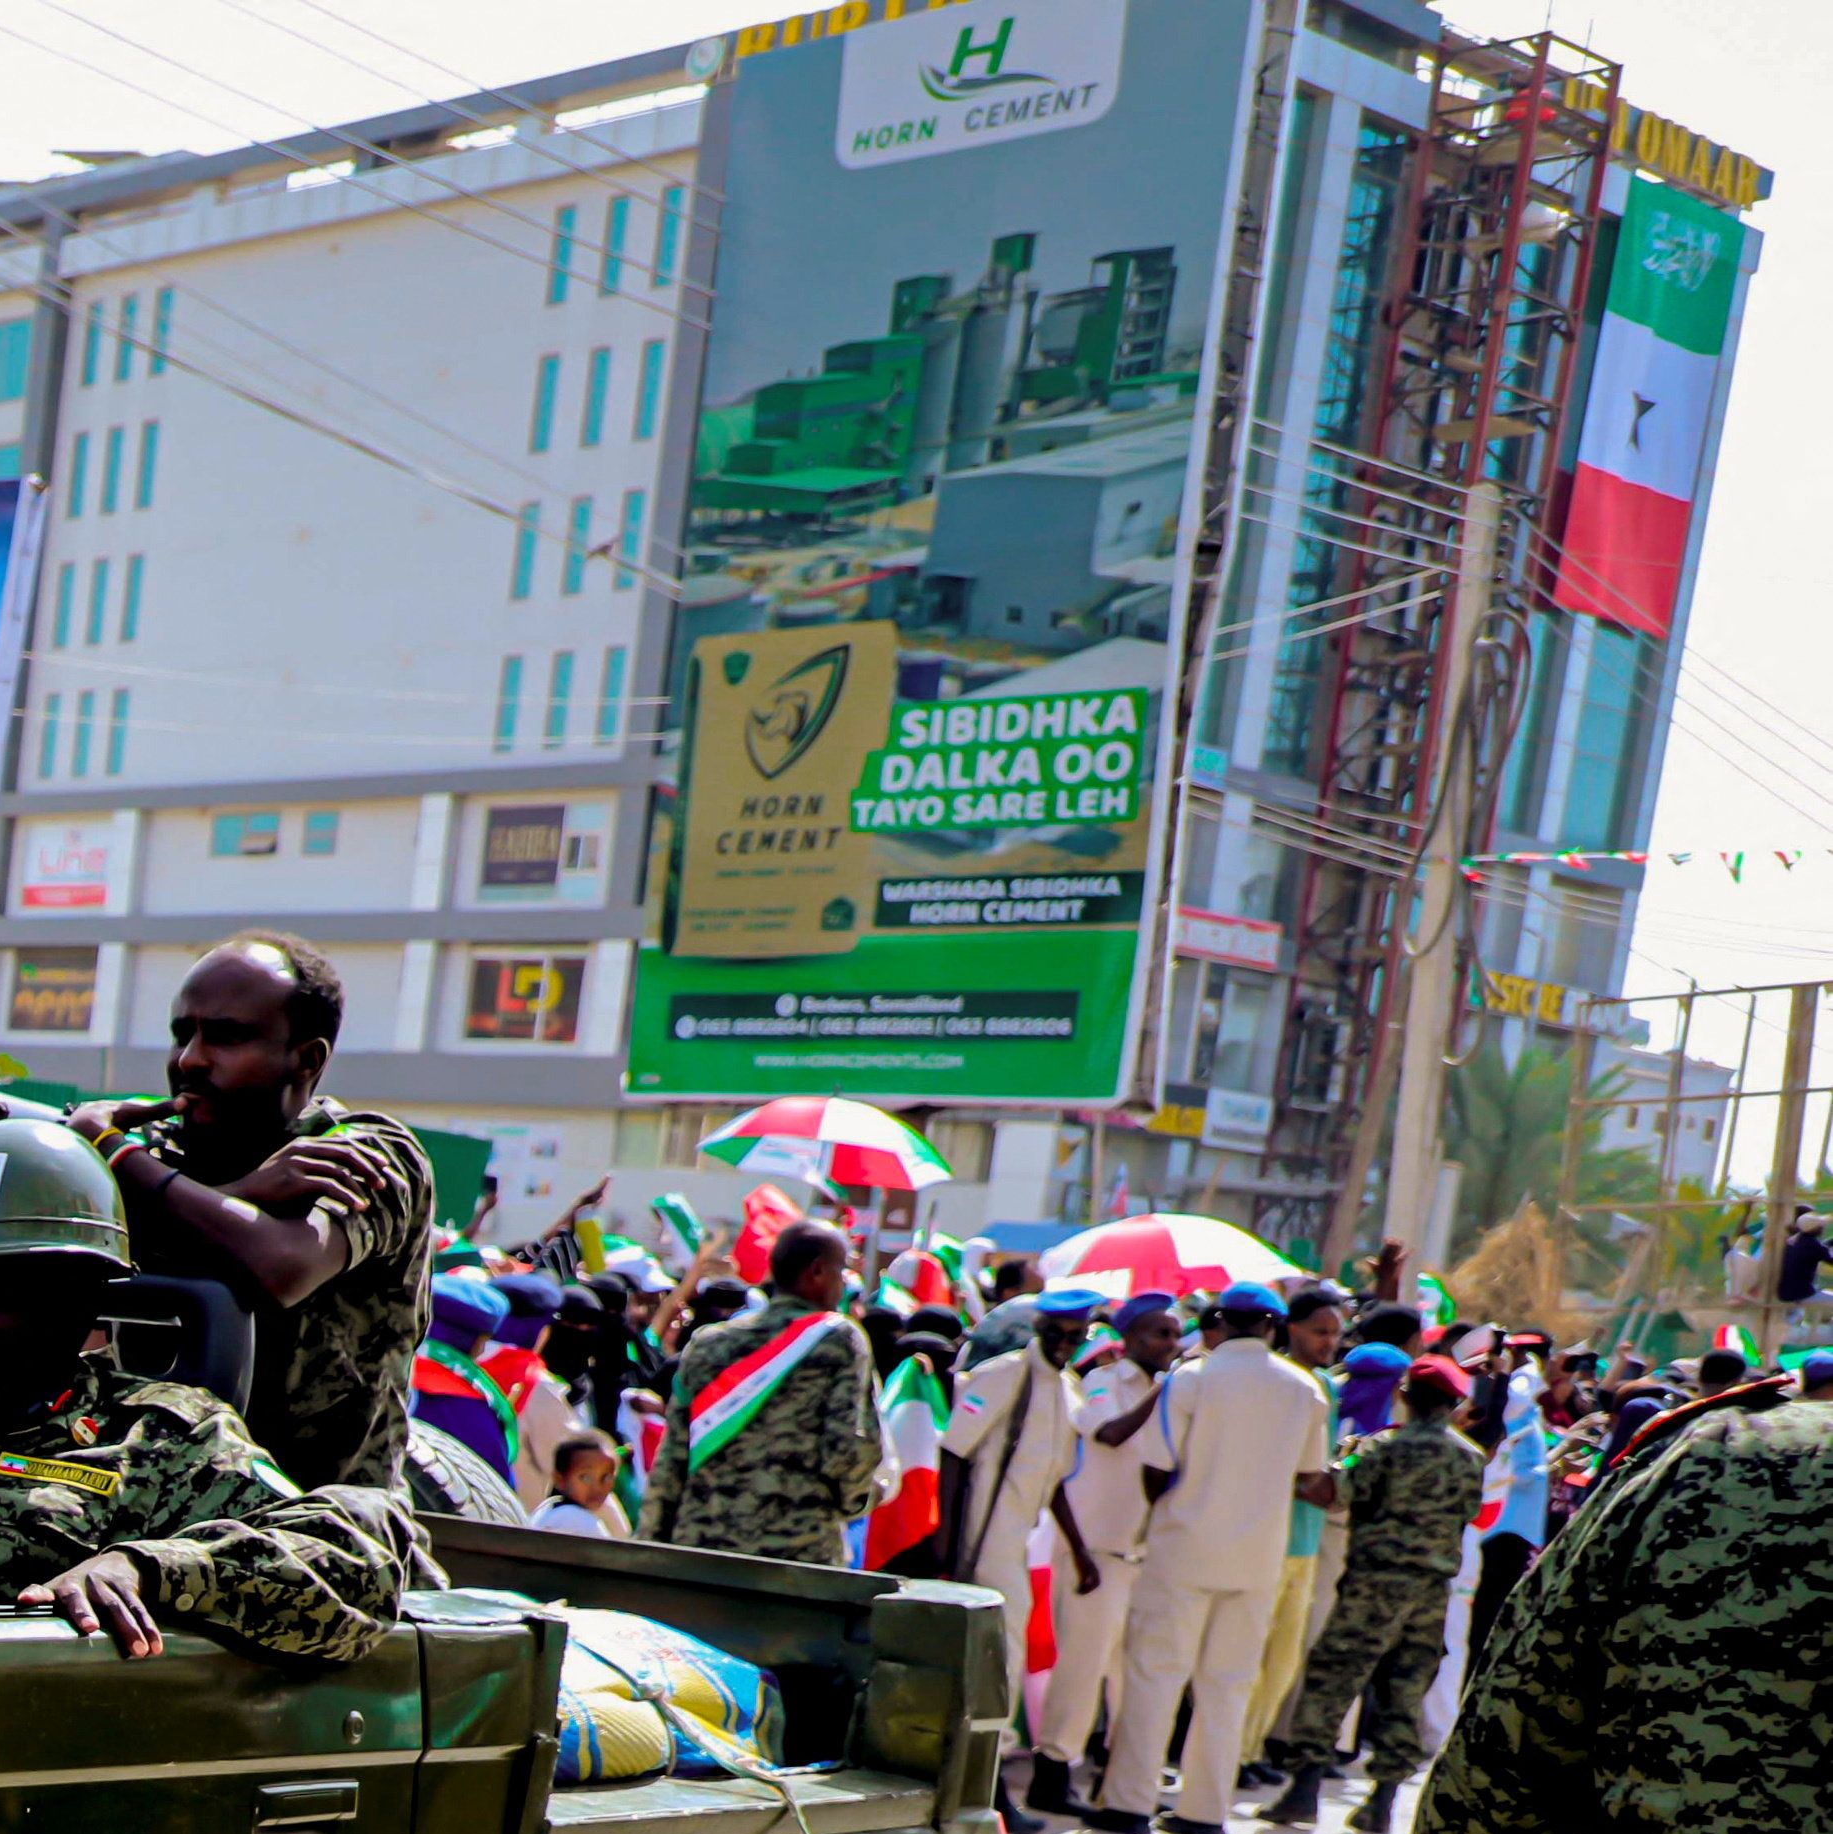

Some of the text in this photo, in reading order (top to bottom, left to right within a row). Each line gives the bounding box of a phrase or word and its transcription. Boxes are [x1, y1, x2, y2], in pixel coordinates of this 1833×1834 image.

[851, 82, 1100, 154] HORN CEMENT
[899, 695, 1138, 749] SIBIDHKA
[880, 741, 1135, 794] DALKA OO
[740, 795, 824, 818] HORN
[853, 786, 1130, 828] TAYO SARE LEH
[716, 826, 843, 855] CEMENT
[882, 876, 1123, 902] WARSHADA SIBIDHKA
[909, 899, 1084, 925] HORN CEMENT
